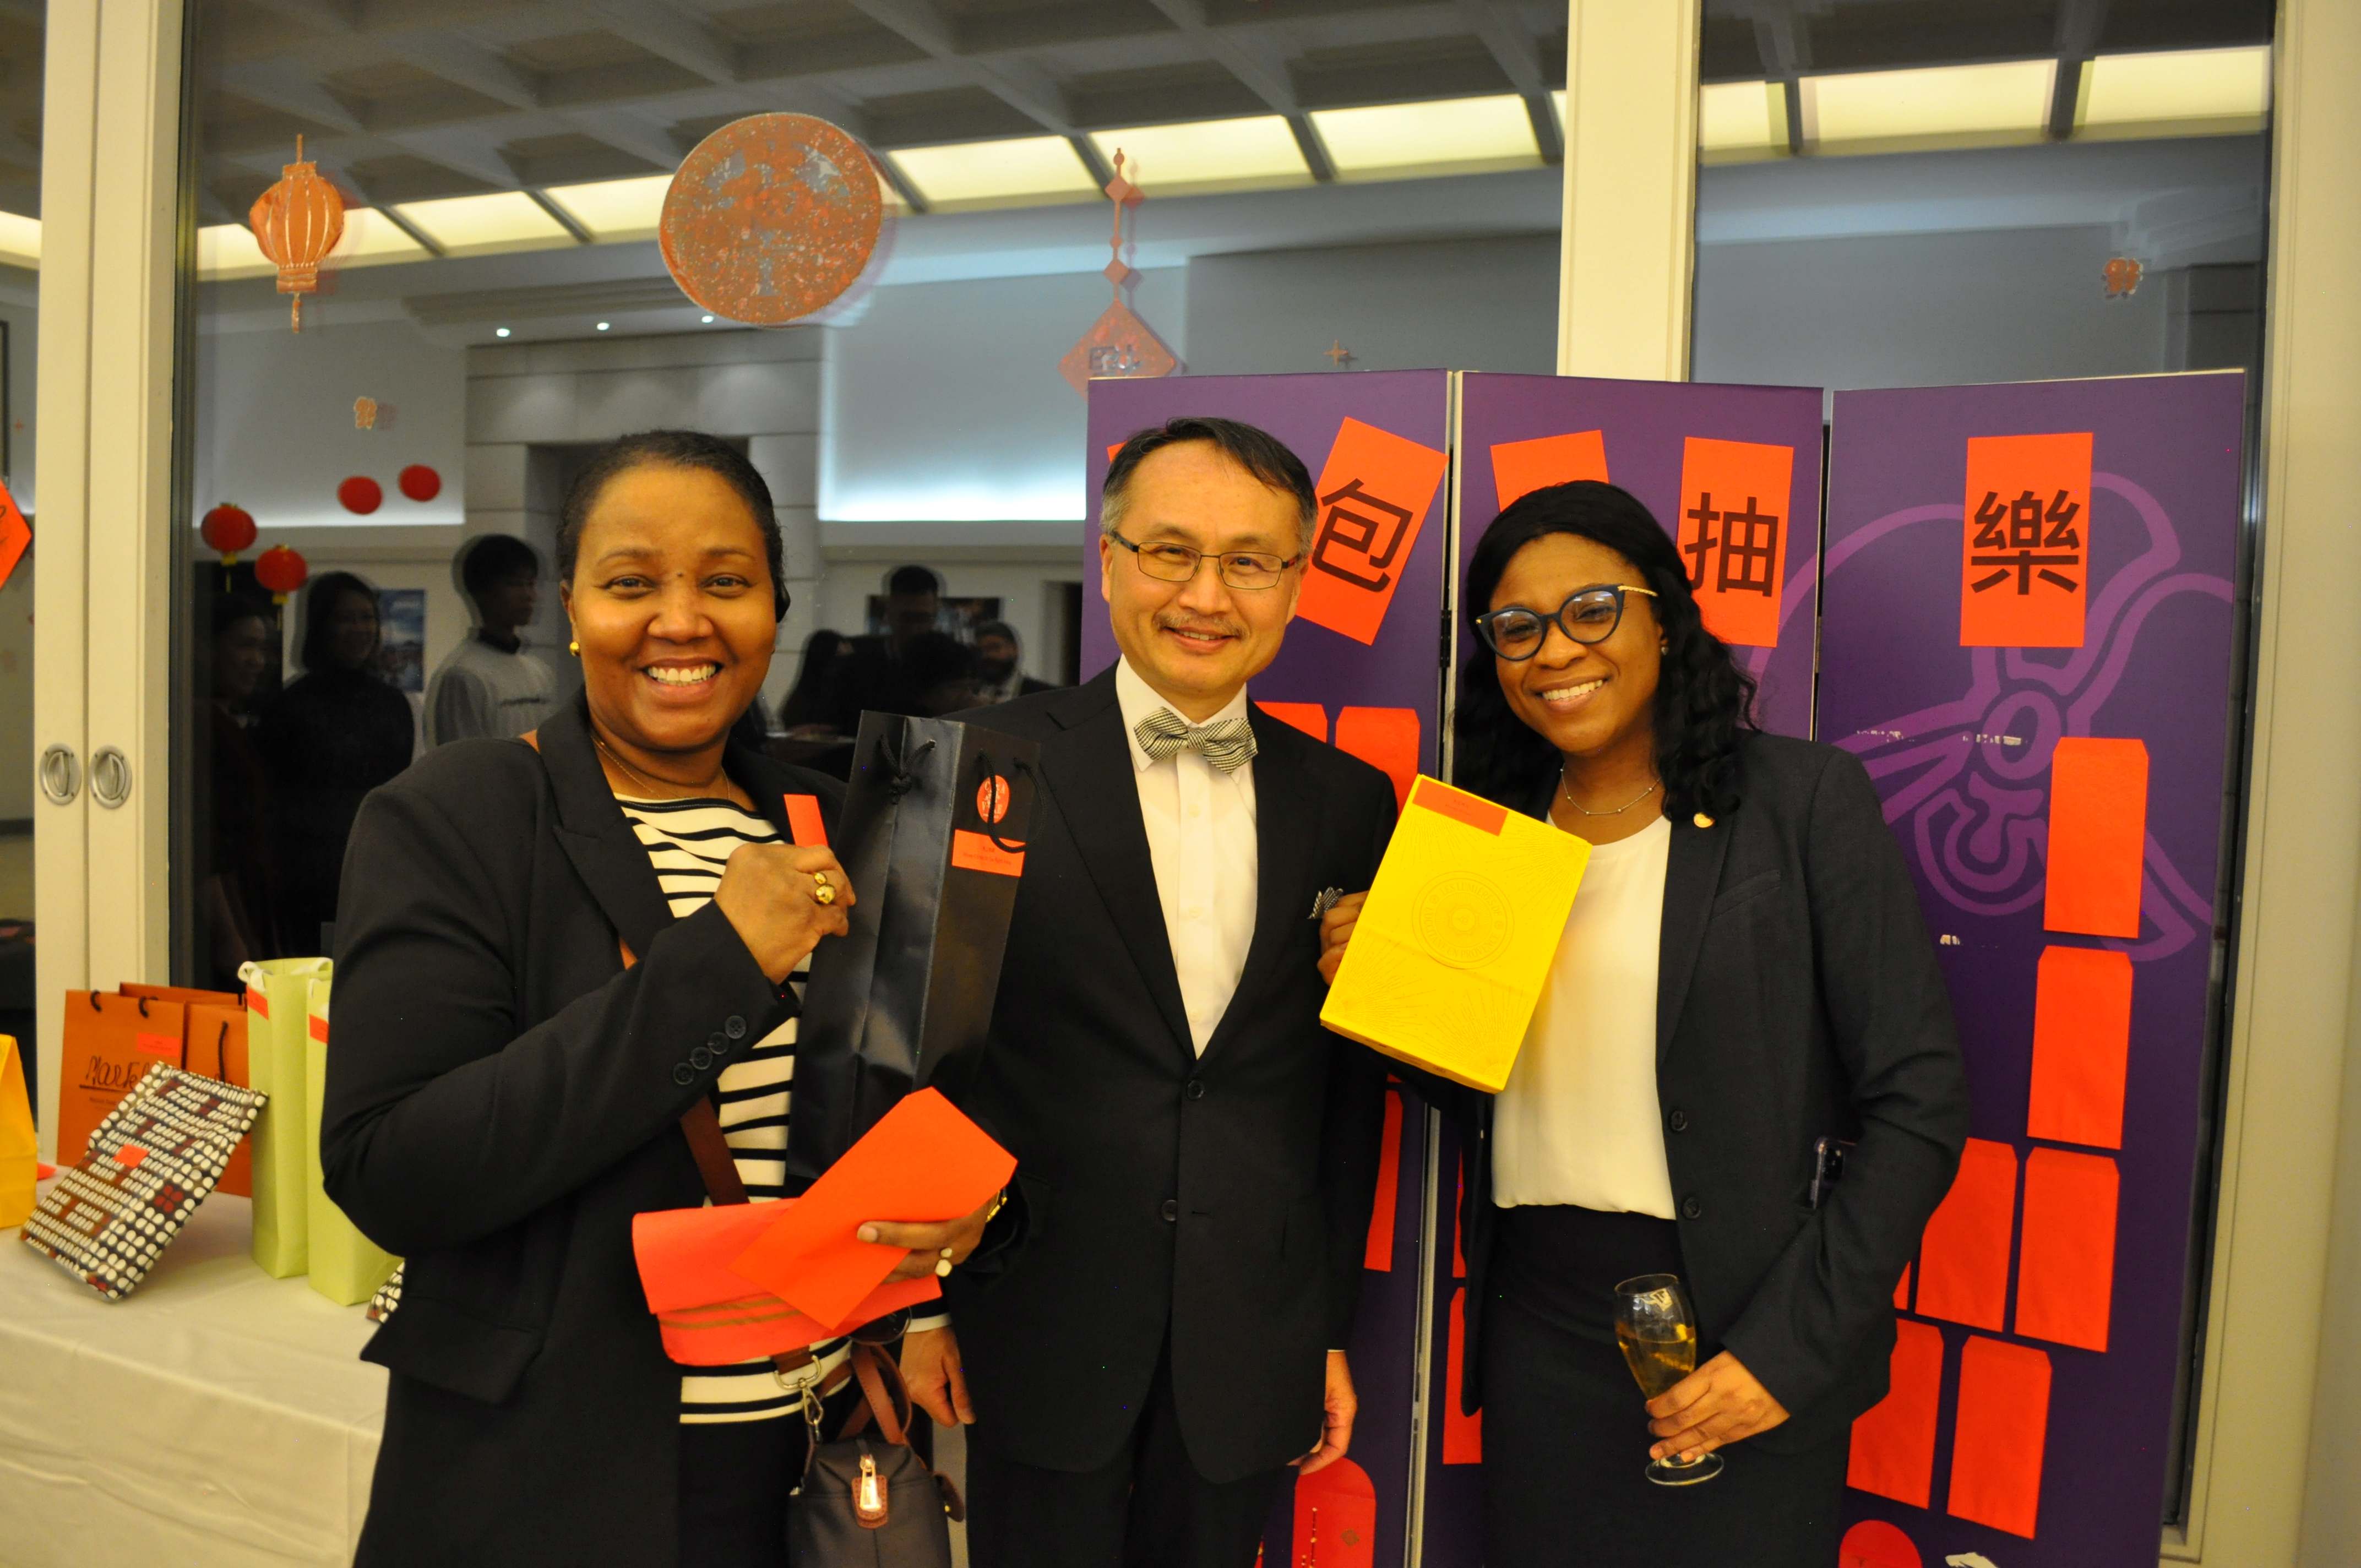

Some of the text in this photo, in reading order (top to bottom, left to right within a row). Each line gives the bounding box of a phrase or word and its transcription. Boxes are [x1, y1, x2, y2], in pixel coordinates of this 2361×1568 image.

[1310, 478, 1413, 593] 包
[1684, 492, 1779, 597] 抽
[1971, 489, 2080, 595] 樂
